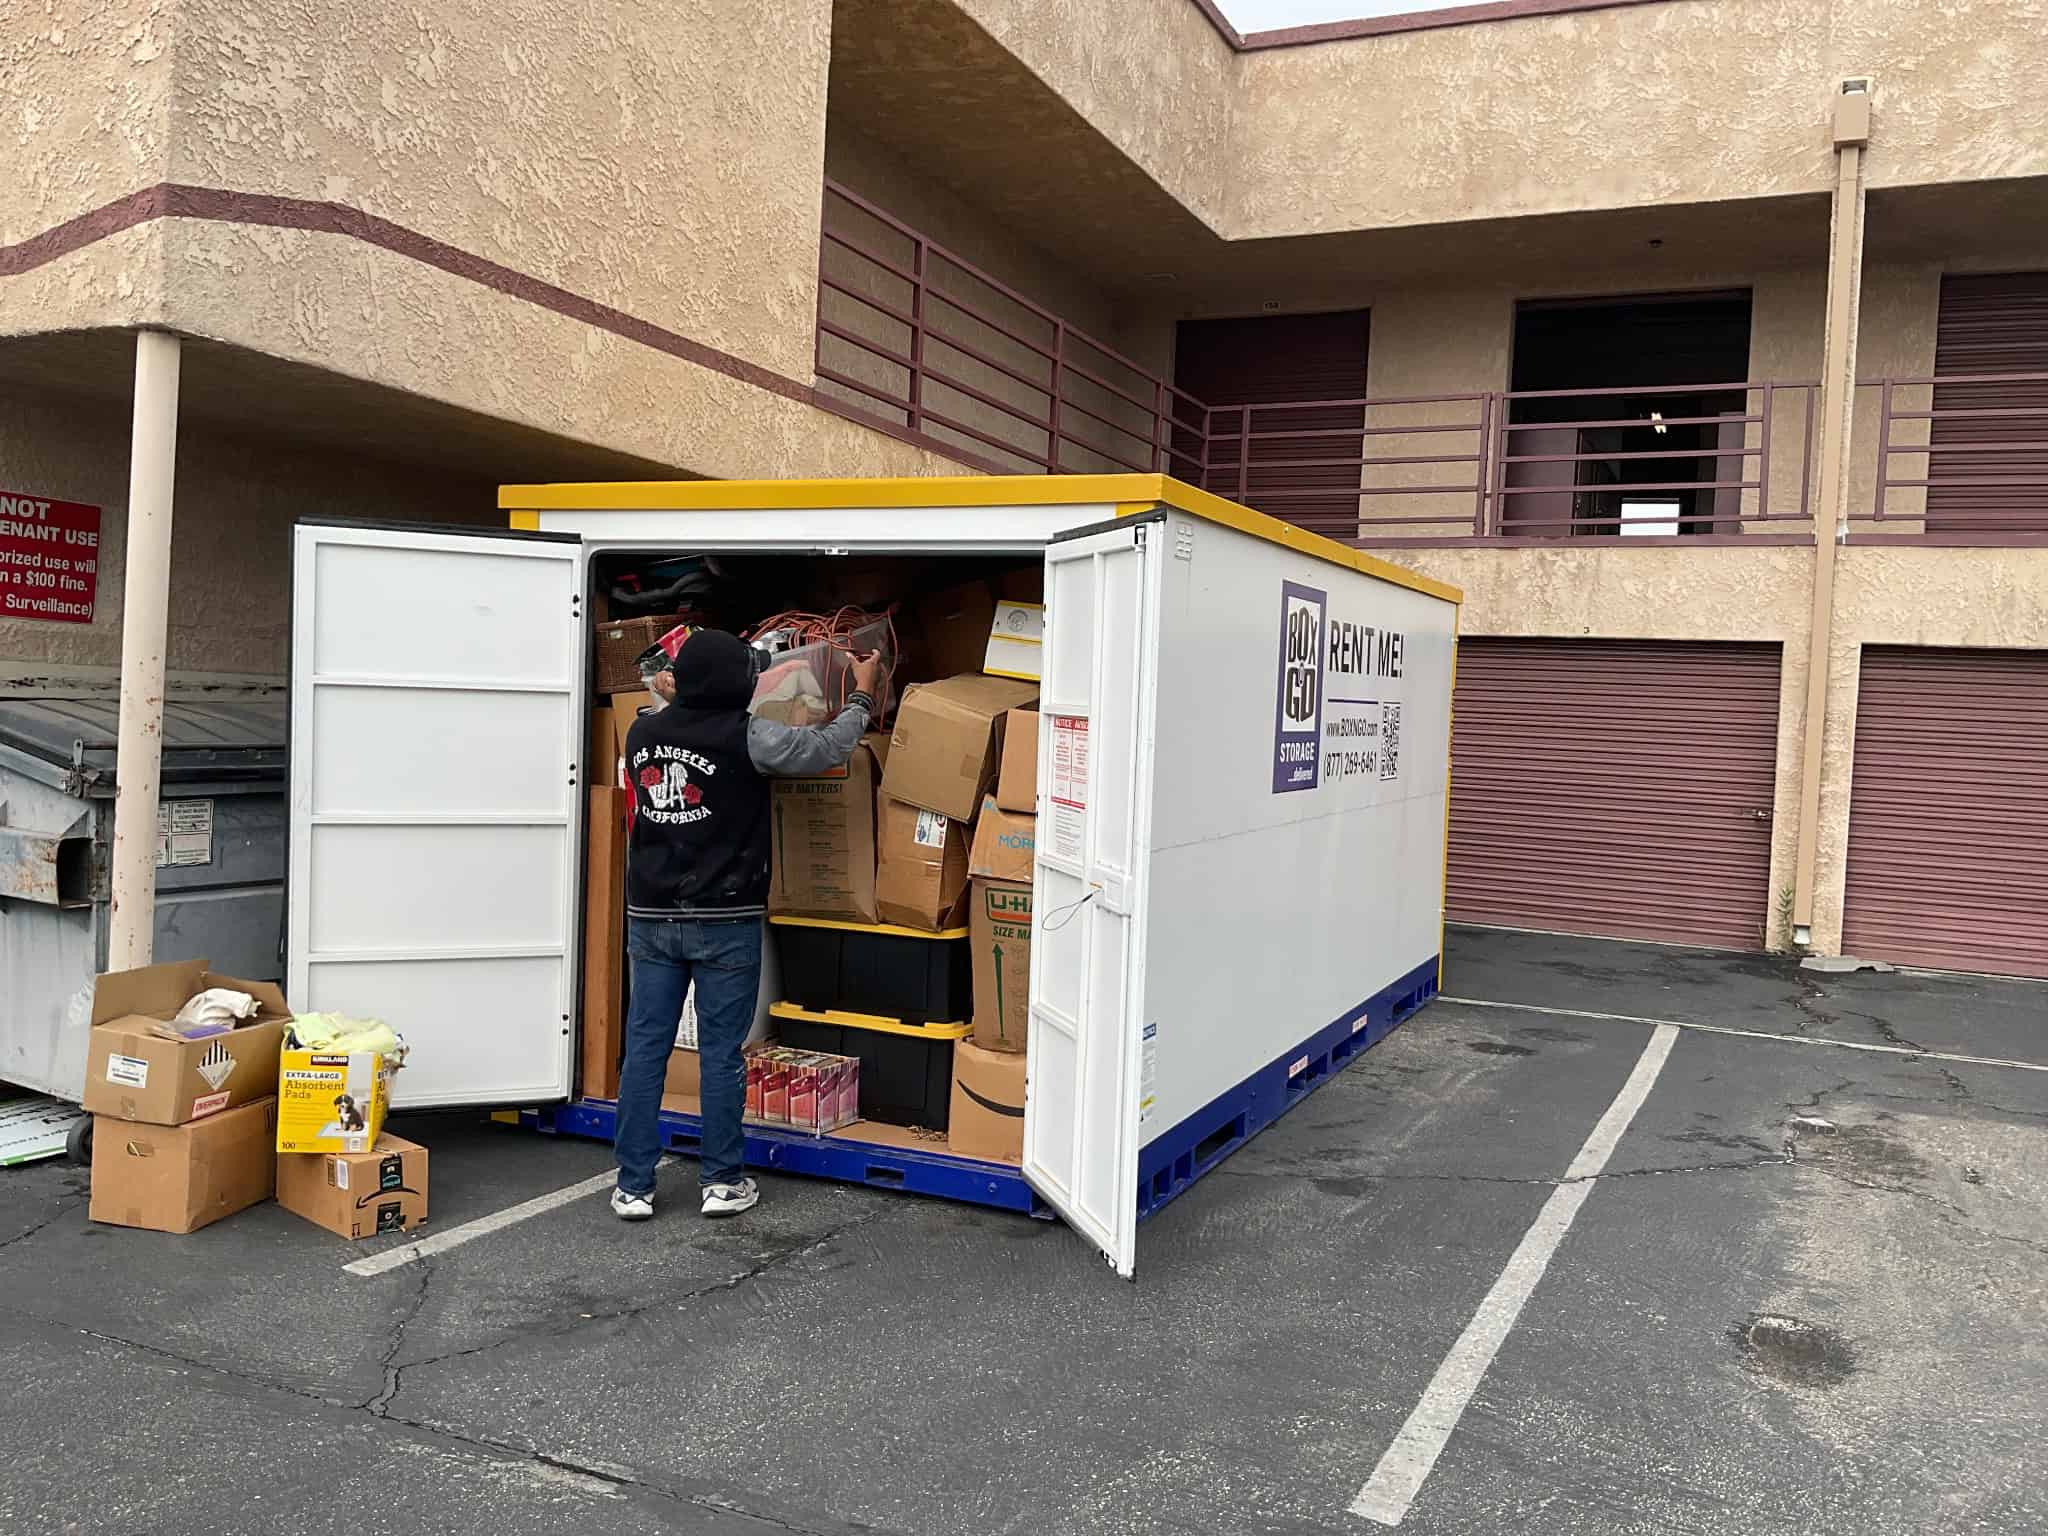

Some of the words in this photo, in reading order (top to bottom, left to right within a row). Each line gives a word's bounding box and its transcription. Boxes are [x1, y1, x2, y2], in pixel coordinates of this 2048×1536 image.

[0, 496, 50, 520] NOT
[0, 520, 60, 542] ENANT
[65, 529, 98, 547] USE
[45, 557, 70, 570] use
[75, 559, 96, 574] will
[13, 572, 21, 584] a
[26, 570, 55, 588] $100
[60, 575, 88, 592] fine.
[5, 593, 93, 619] Surveillance)
[1287, 607, 1318, 665] BOX
[1328, 620, 1375, 674] RENT
[1377, 629, 1404, 678] ME!
[653, 745, 717, 776] ANGELES
[1279, 742, 1315, 763] STORAGE
[1323, 752, 1343, 782] (877)
[992, 925, 1014, 938] SIZE
[286, 1071, 340, 1080] EXTRA-LARGE
[286, 1080, 344, 1090] Absorbent
[285, 1090, 312, 1099] Pads
